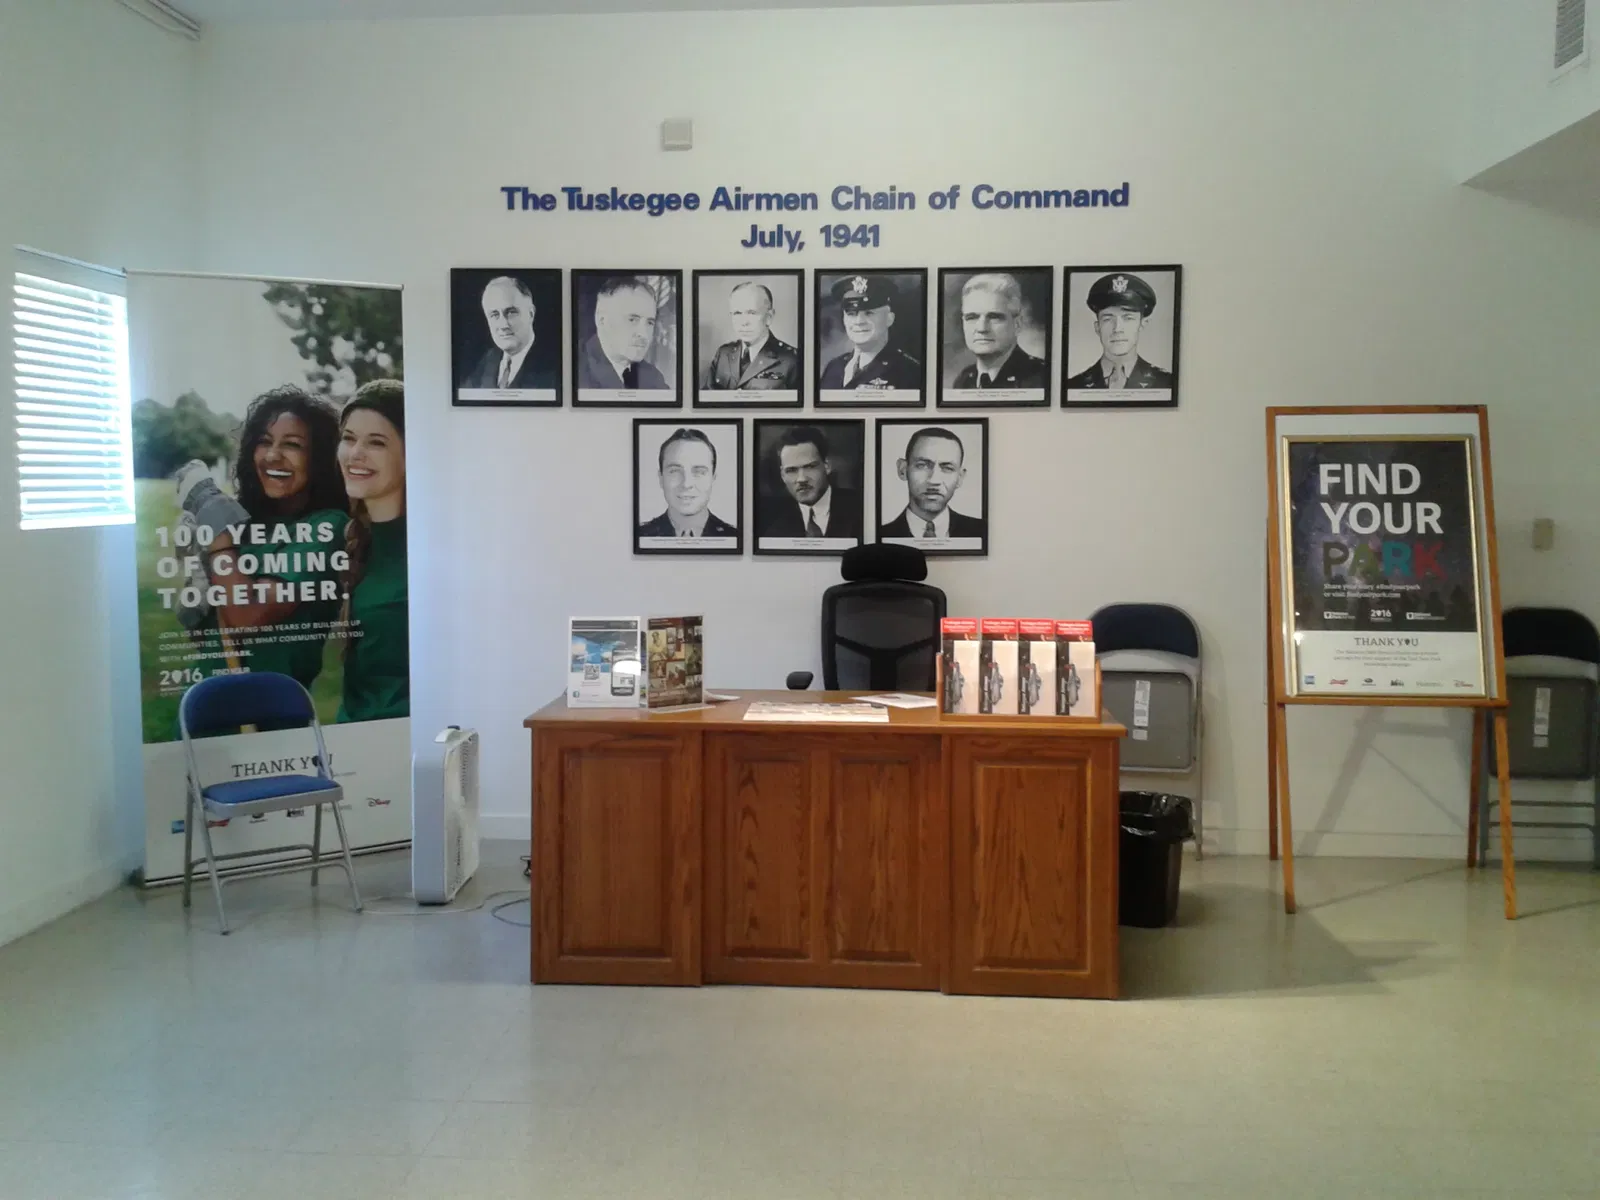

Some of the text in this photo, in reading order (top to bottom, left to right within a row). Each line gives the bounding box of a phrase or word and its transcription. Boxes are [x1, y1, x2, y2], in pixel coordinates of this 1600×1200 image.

[501, 181, 1130, 217] The Tuskegee Airmen Chain of Command
[741, 223, 880, 253] July, 1941
[1319, 463, 1421, 495] FIND
[1320, 502, 1444, 535] YOUR
[155, 521, 335, 548] 100 YEARS
[156, 550, 350, 579] OF COMING
[1322, 540, 1448, 582] PARK
[156, 580, 350, 609] TOGETHER.
[158, 631, 179, 639] JOIN
[181, 630, 192, 638] US
[203, 625, 259, 636] CELEBRATING
[260, 624, 273, 632] 100
[275, 623, 299, 631] YEARS
[312, 620, 349, 629] BUILDING
[222, 639, 241, 647] TELL
[255, 636, 277, 644] WHAT
[279, 633, 326, 643] COMMUNITY
[337, 631, 347, 639] TO
[1354, 637, 1395, 646] THANK
[231, 757, 296, 778] THANK
